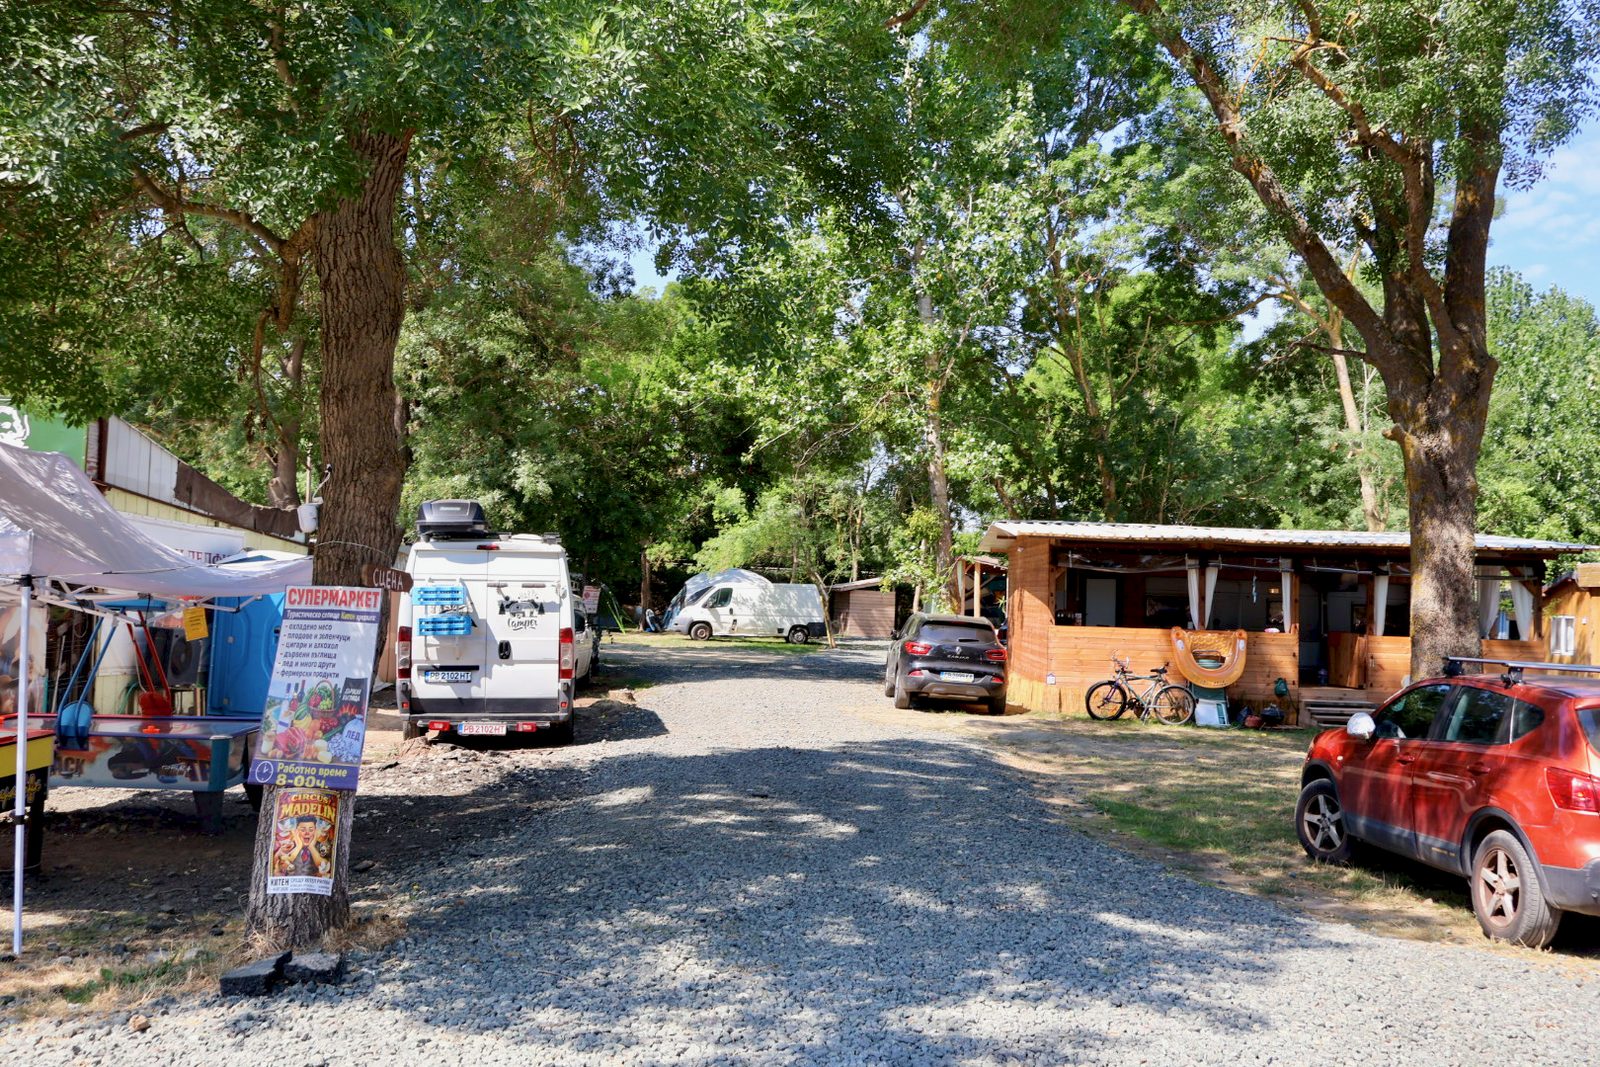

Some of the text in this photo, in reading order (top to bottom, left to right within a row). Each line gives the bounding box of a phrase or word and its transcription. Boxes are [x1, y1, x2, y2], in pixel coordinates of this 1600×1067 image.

[373, 568, 403, 590] СЦЕНА
[288, 588, 379, 608] СУПЕРМАРКЕТ
[285, 642, 308, 650] цигари
[318, 662, 336, 670] други
[280, 669, 339, 679] фермерски продукти
[346, 729, 360, 741] ЛЕД
[277, 763, 348, 779] Работно време
[291, 794, 329, 803] CIRCUS
[280, 803, 336, 822] MADELIN
